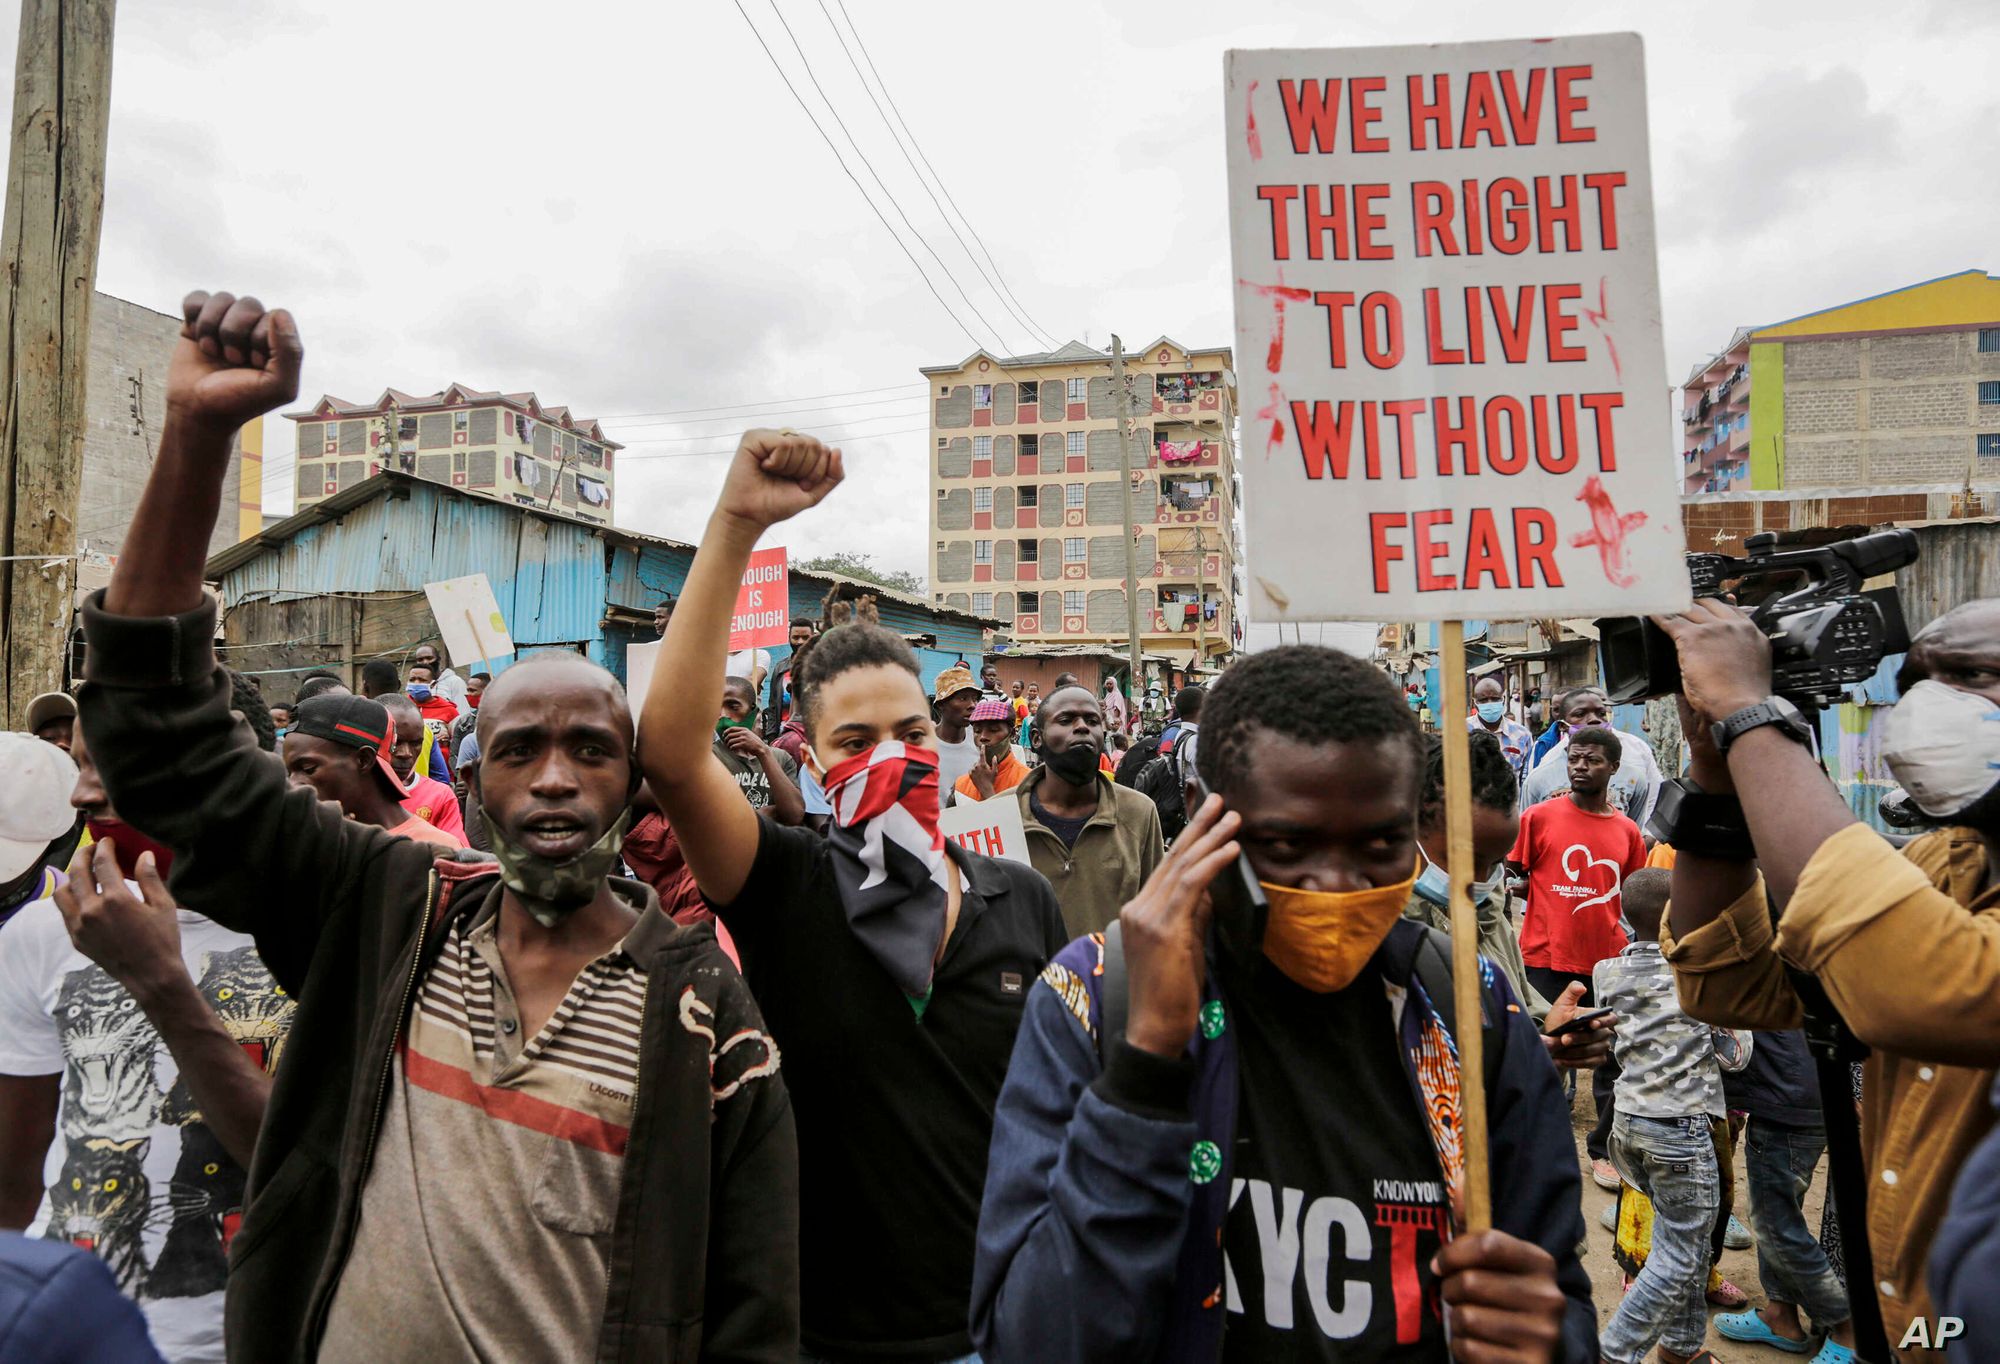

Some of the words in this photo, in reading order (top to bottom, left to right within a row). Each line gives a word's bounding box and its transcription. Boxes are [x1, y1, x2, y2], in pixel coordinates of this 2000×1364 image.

[1278, 77, 1390, 154] WE
[1407, 64, 1597, 151] HAVE
[1257, 183, 1395, 261] THE
[1410, 171, 1627, 257] RIGHT
[1314, 290, 1405, 369] TO
[1423, 283, 1588, 366] LIVE
[1290, 392, 1624, 479] WITHOUT
[1369, 506, 1565, 594] FEAR
[749, 590, 763, 608] IS
[589, 1082, 629, 1103] LACOSTE
